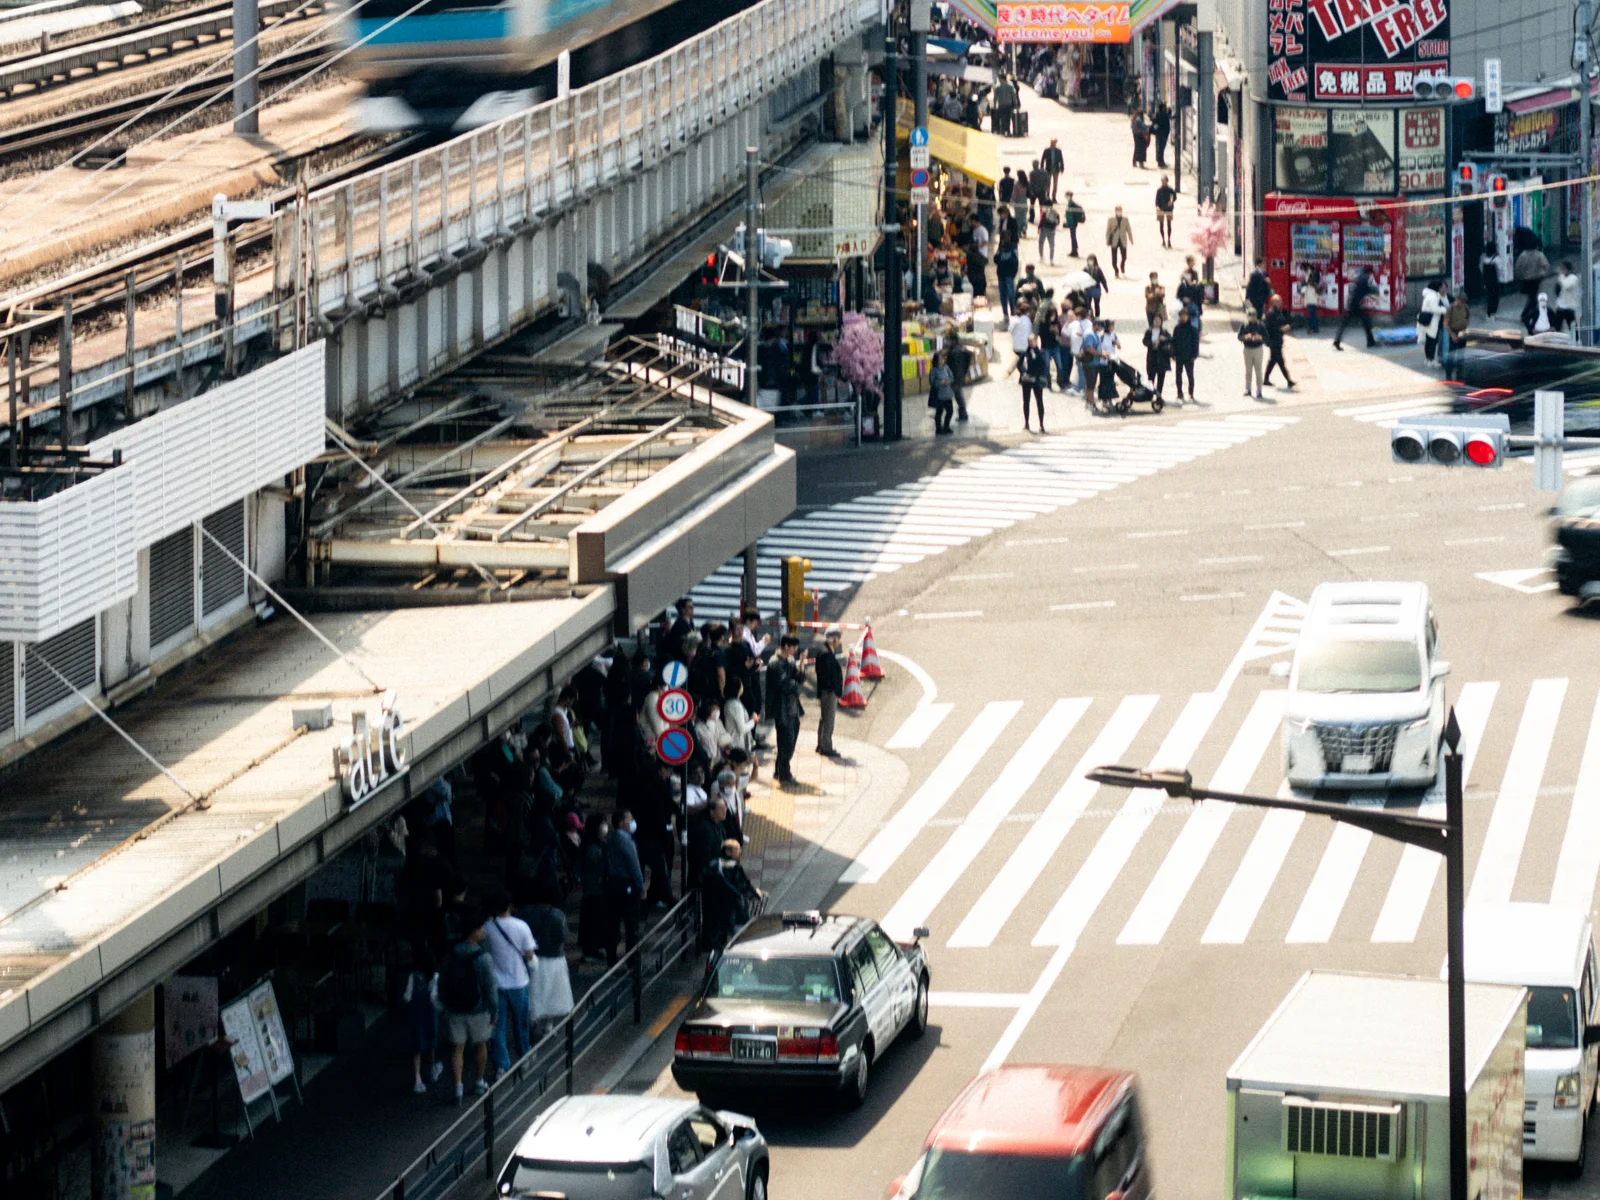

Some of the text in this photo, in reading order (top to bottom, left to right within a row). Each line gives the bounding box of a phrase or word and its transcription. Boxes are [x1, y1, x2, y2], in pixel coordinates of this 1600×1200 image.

[1000, 27, 1062, 40] welcome
[1268, 57, 1291, 85] TAX
[666, 698, 685, 716] 30
